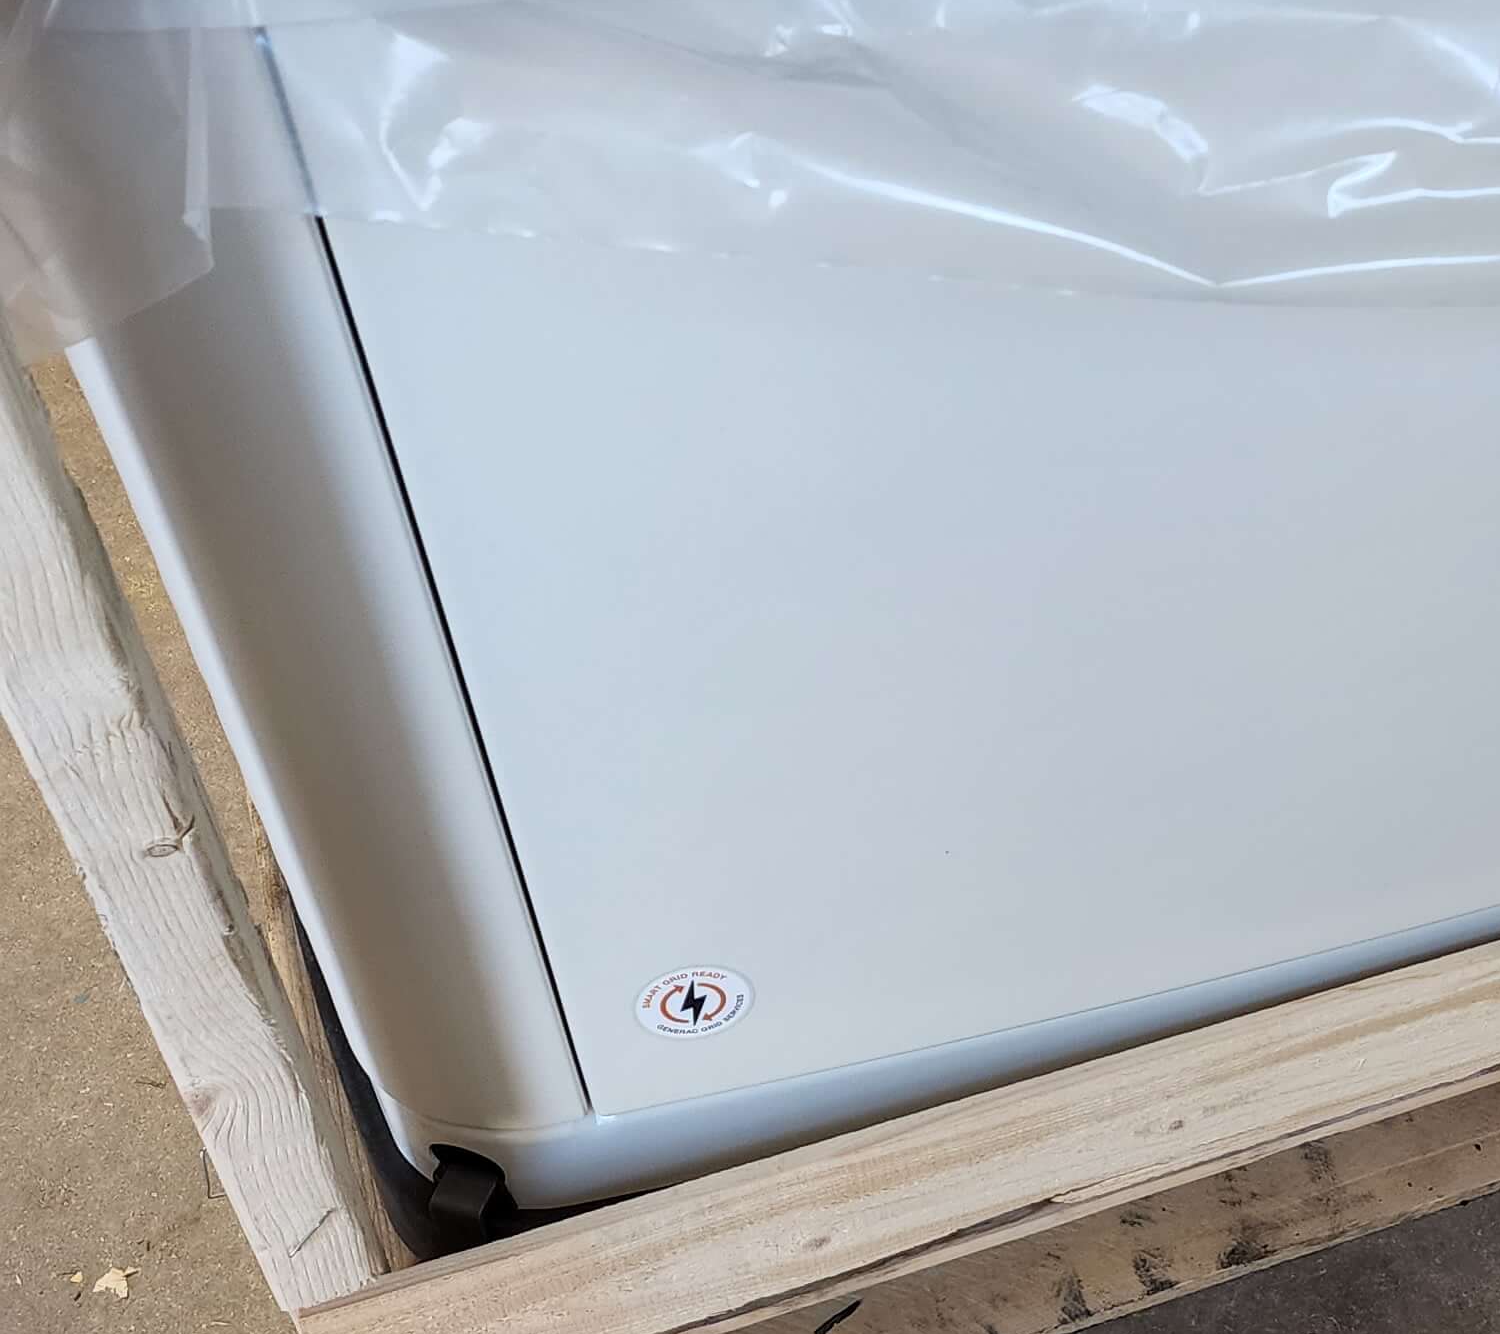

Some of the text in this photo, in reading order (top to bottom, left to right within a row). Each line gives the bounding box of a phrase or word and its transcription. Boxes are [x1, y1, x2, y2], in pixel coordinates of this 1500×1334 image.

[662, 973, 689, 986] GRID
[691, 970, 728, 981] READY
[656, 1023, 699, 1035] GENERAC
[700, 1020, 723, 1033] GRID
